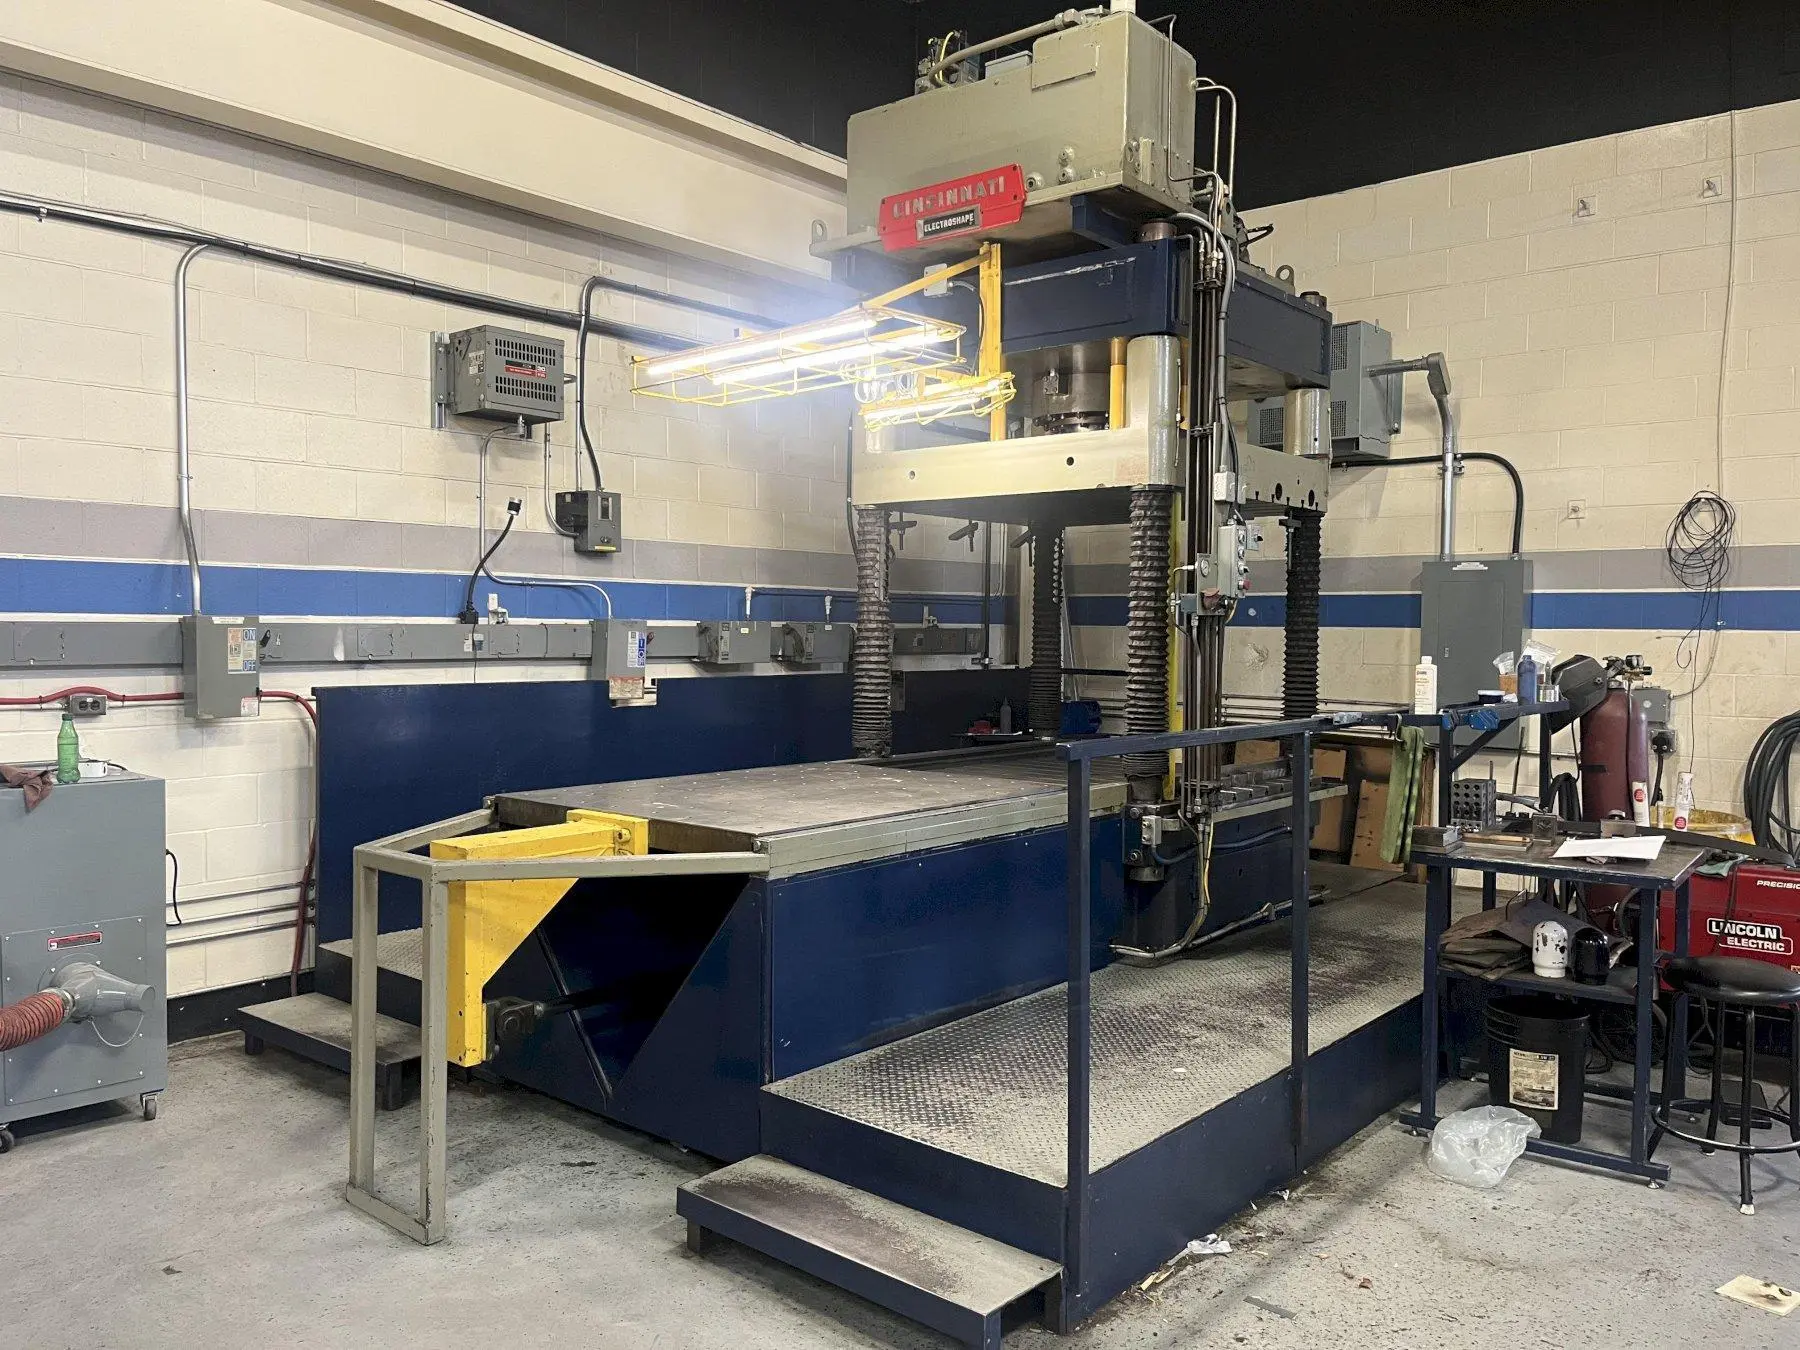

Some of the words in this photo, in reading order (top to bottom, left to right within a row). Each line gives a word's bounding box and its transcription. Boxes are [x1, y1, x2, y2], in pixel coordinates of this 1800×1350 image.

[924, 213, 974, 232] ELECTROSHAPE
[243, 629, 256, 640] ON
[1726, 937, 1785, 951] ELECTRIC
